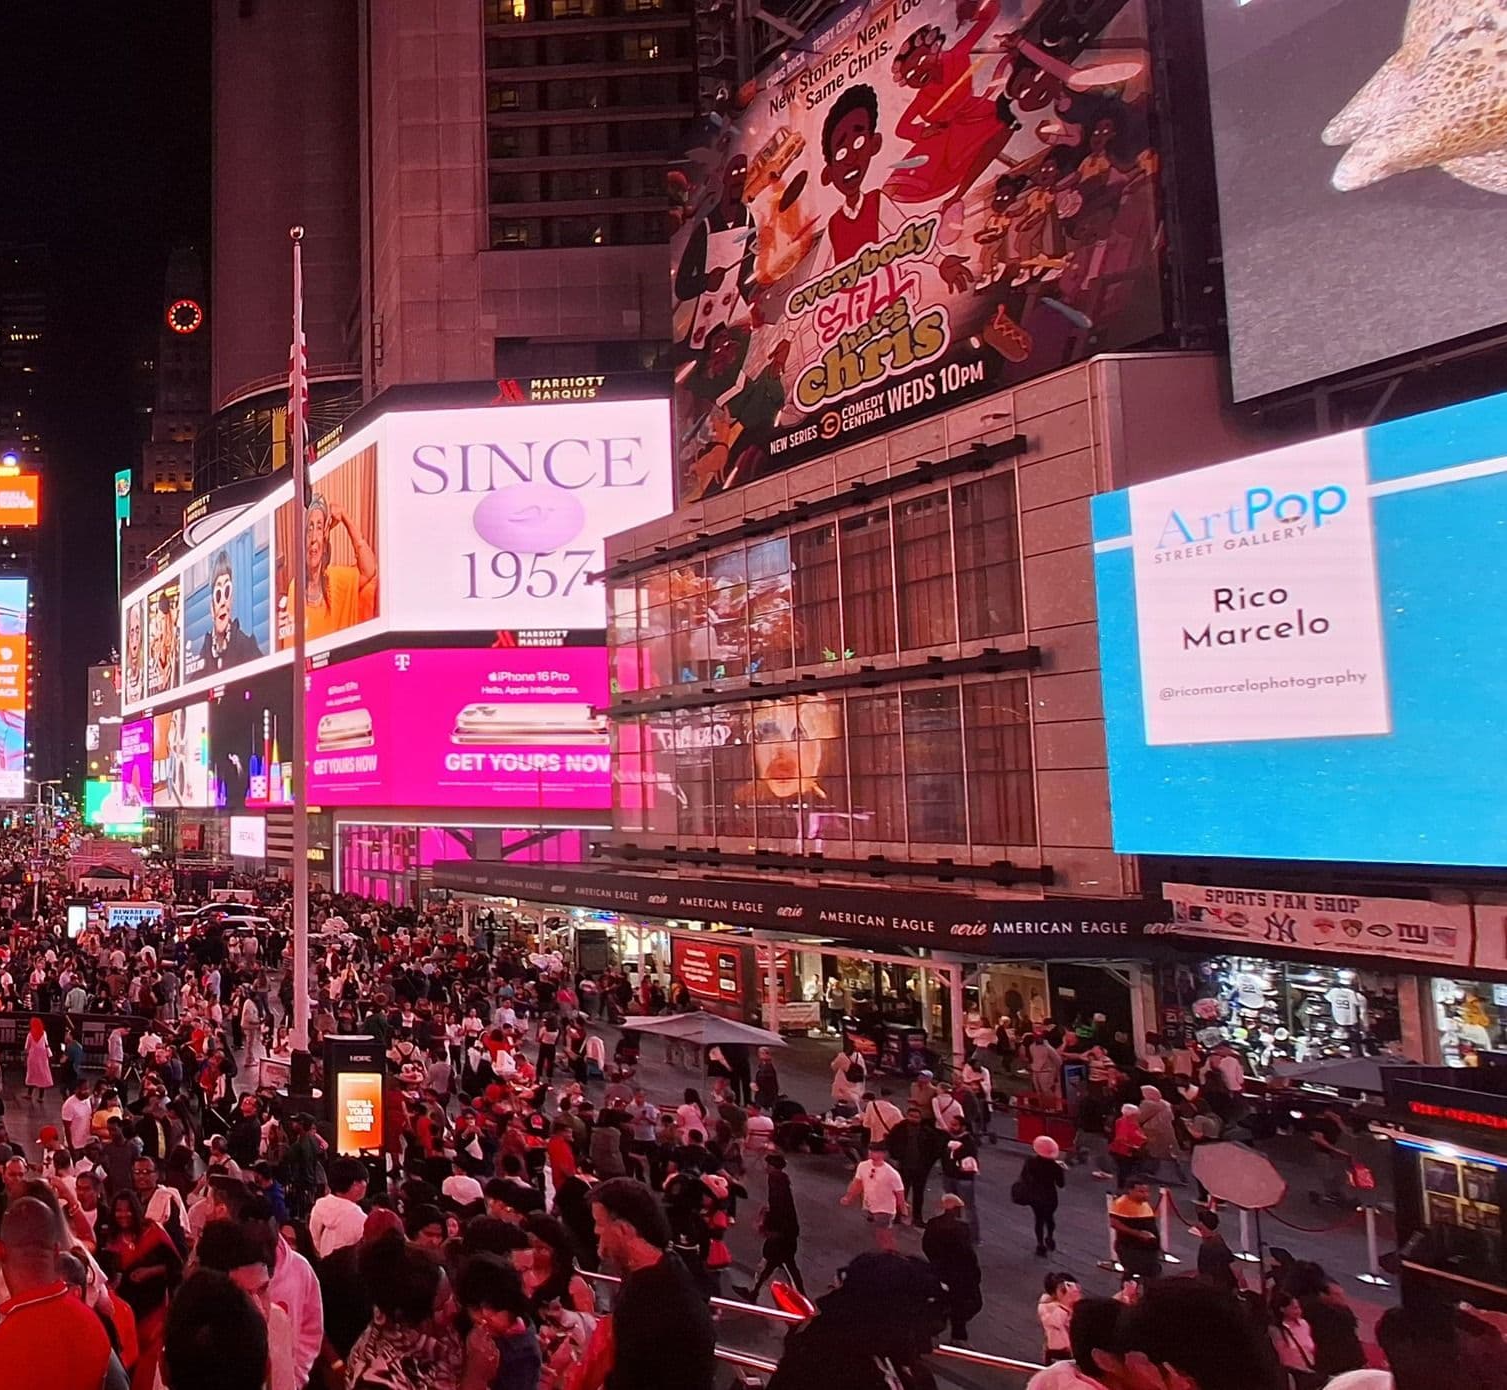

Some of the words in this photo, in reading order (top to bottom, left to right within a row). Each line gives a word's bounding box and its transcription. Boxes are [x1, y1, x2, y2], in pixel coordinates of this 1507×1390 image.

[770, 85, 796, 117] New
[800, 51, 853, 92] Stories.
[857, 15, 889, 50] New
[806, 74, 844, 110] Same
[848, 39, 892, 79] Chris.
[789, 217, 937, 314] everybody
[838, 296, 908, 349] hates
[797, 311, 944, 406] chris
[531, 376, 605, 388] MARRIOTT
[532, 389, 596, 400] MARQUIS
[887, 374, 936, 413] WEDS
[842, 392, 885, 419] COMEDY
[842, 407, 886, 431] CENTRAL
[770, 437, 787, 455] NEW
[789, 425, 817, 447] SERIES
[411, 437, 650, 495] SINCE
[1155, 484, 1348, 549] ArtPop
[1154, 543, 1213, 564] STREET
[1223, 524, 1308, 551] GALLERY
[461, 550, 596, 600] 1957
[1214, 587, 1288, 613] Rico
[1182, 608, 1330, 650] Marcelo
[537, 671, 550, 682] 16
[551, 671, 570, 682] Pro
[1159, 669, 1367, 701] @ricomarcelophotography
[445, 753, 486, 771] GET
[489, 753, 561, 772] YOURS
[575, 887, 612, 898] AMERICAN
[615, 891, 638, 901] EAGLE
[679, 897, 727, 910] AMERICAN
[732, 901, 764, 913] EAGLE
[1205, 889, 1266, 906] SPORTS
[1273, 894, 1307, 910] FAN
[1314, 896, 1360, 913] SHOP
[819, 911, 885, 927] AMERICAN
[892, 917, 935, 933] EAGLE
[950, 920, 988, 937] aerie
[992, 921, 1072, 934] AMERICAN
[1081, 921, 1128, 934] EAGLE
[348, 1107, 372, 1115] YOUR
